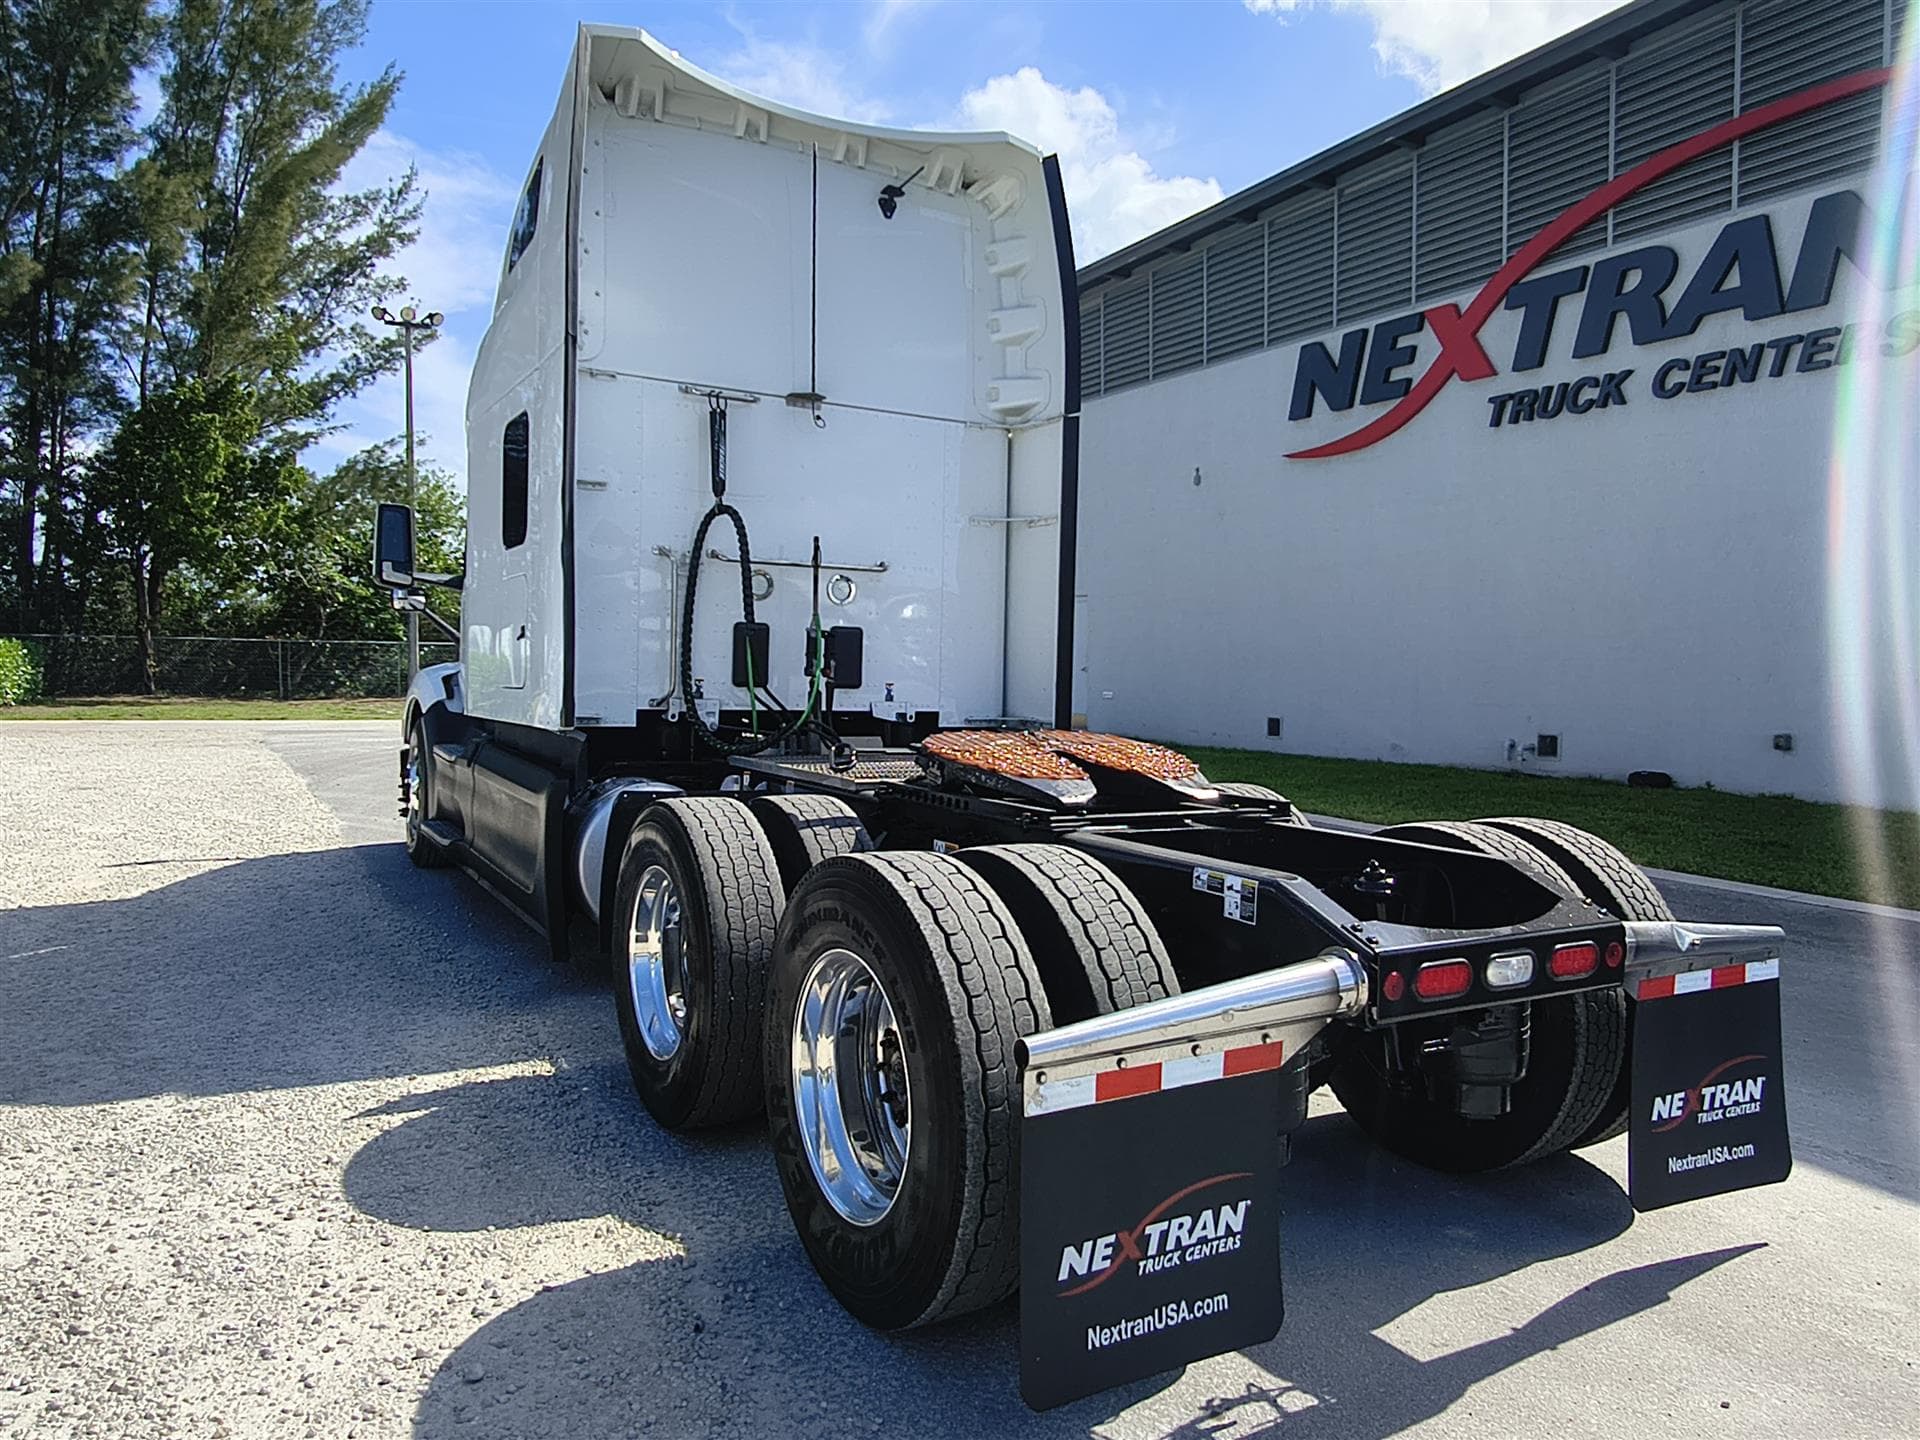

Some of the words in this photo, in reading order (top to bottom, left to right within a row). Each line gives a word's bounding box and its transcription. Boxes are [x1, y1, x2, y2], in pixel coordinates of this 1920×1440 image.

[1288, 170, 1920, 421] NEXTRAN
[1488, 369, 1635, 428] TRUCK
[1651, 1077, 1763, 1121] NEXTRAN
[1697, 1109, 1724, 1124] TRUCK
[1726, 1102, 1761, 1118] CENTERS
[1668, 1143, 1755, 1174] NextranUSA.com
[1058, 1200, 1248, 1281] NEXTRAN
[1138, 1251, 1181, 1277] TRUCK
[1185, 1235, 1242, 1262] CENTERS
[1087, 1292, 1229, 1351] NextranUSA.com
